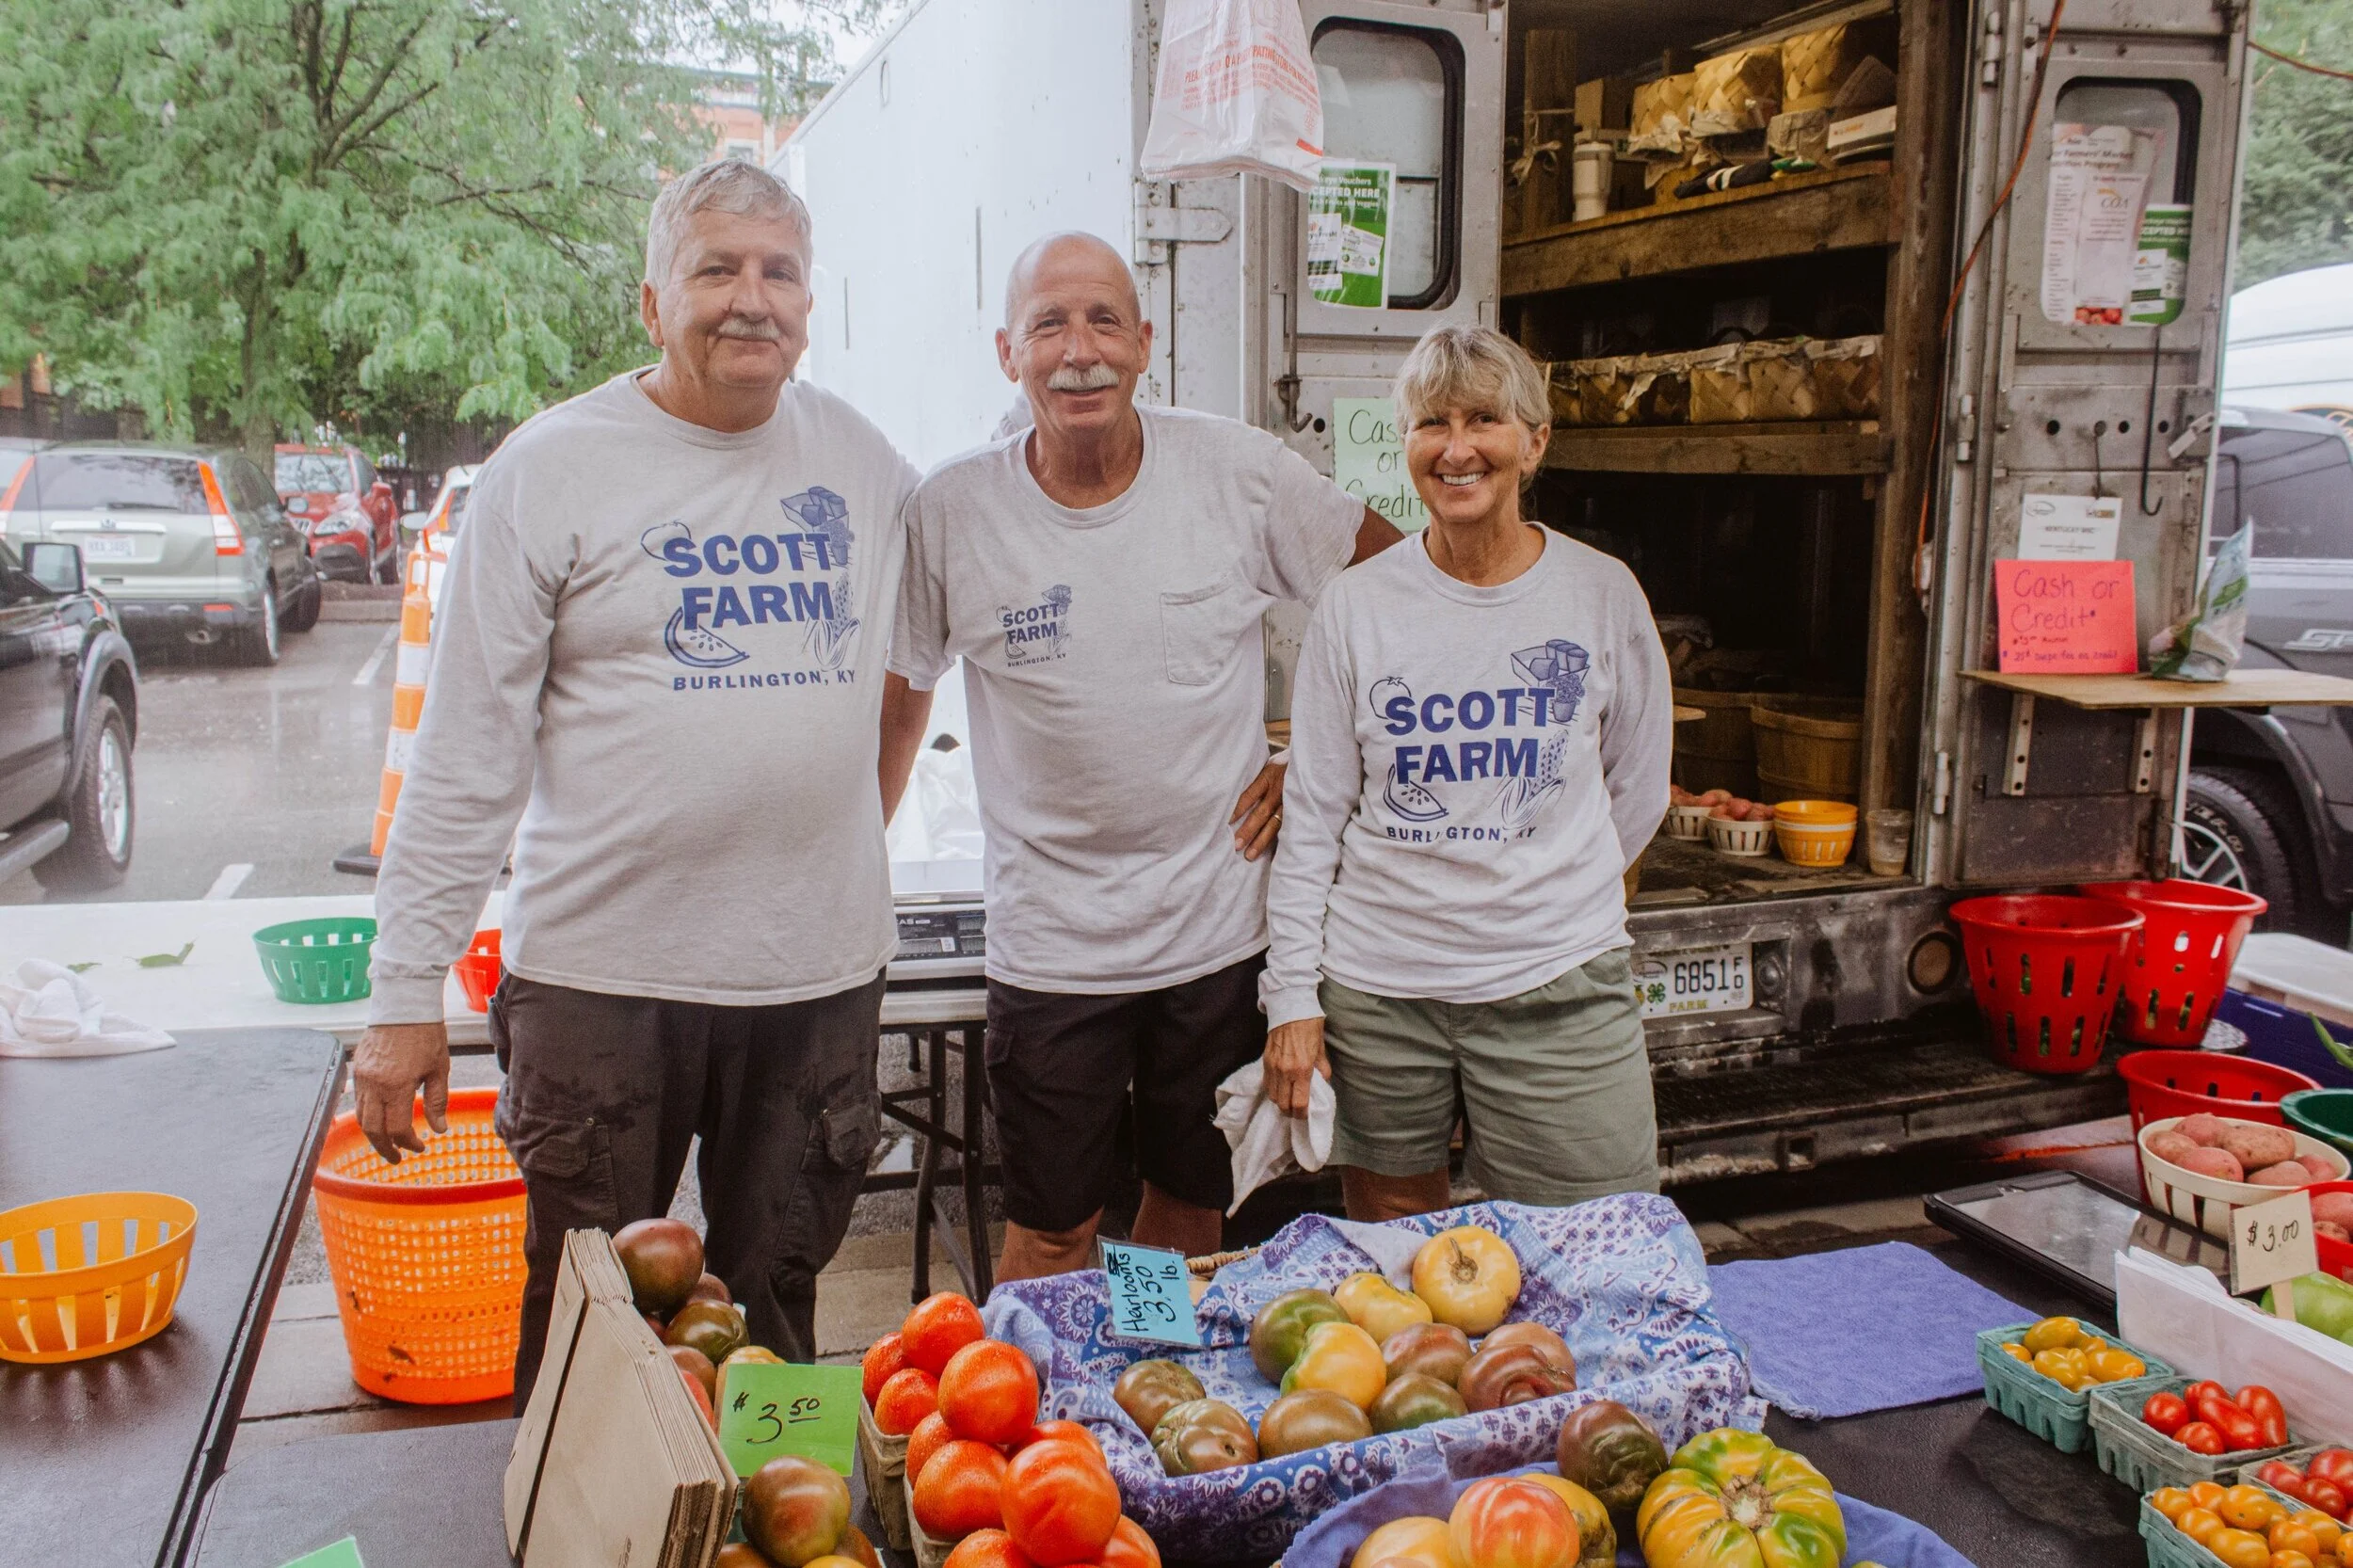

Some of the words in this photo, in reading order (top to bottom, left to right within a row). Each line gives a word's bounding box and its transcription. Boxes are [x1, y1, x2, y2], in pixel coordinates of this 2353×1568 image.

[1353, 188, 1380, 198] HERE
[1349, 408, 1398, 445] Cas
[1377, 450, 1404, 472] or
[663, 532, 832, 578] SCOTT
[2012, 568, 2074, 599] Cash
[2091, 579, 2121, 600] or
[681, 582, 835, 631] FARM
[1002, 602, 1060, 628] SCOTT
[1006, 622, 1058, 644] FARM
[1008, 655, 1054, 667] BURLINGTON,
[673, 670, 829, 691] BURLINGTON,
[837, 668, 856, 683] KY
[1385, 687, 1555, 735] SCOTT
[1395, 738, 1539, 784] FARM
[1674, 956, 1730, 994] 6851
[1669, 1000, 1709, 1014] FARM
